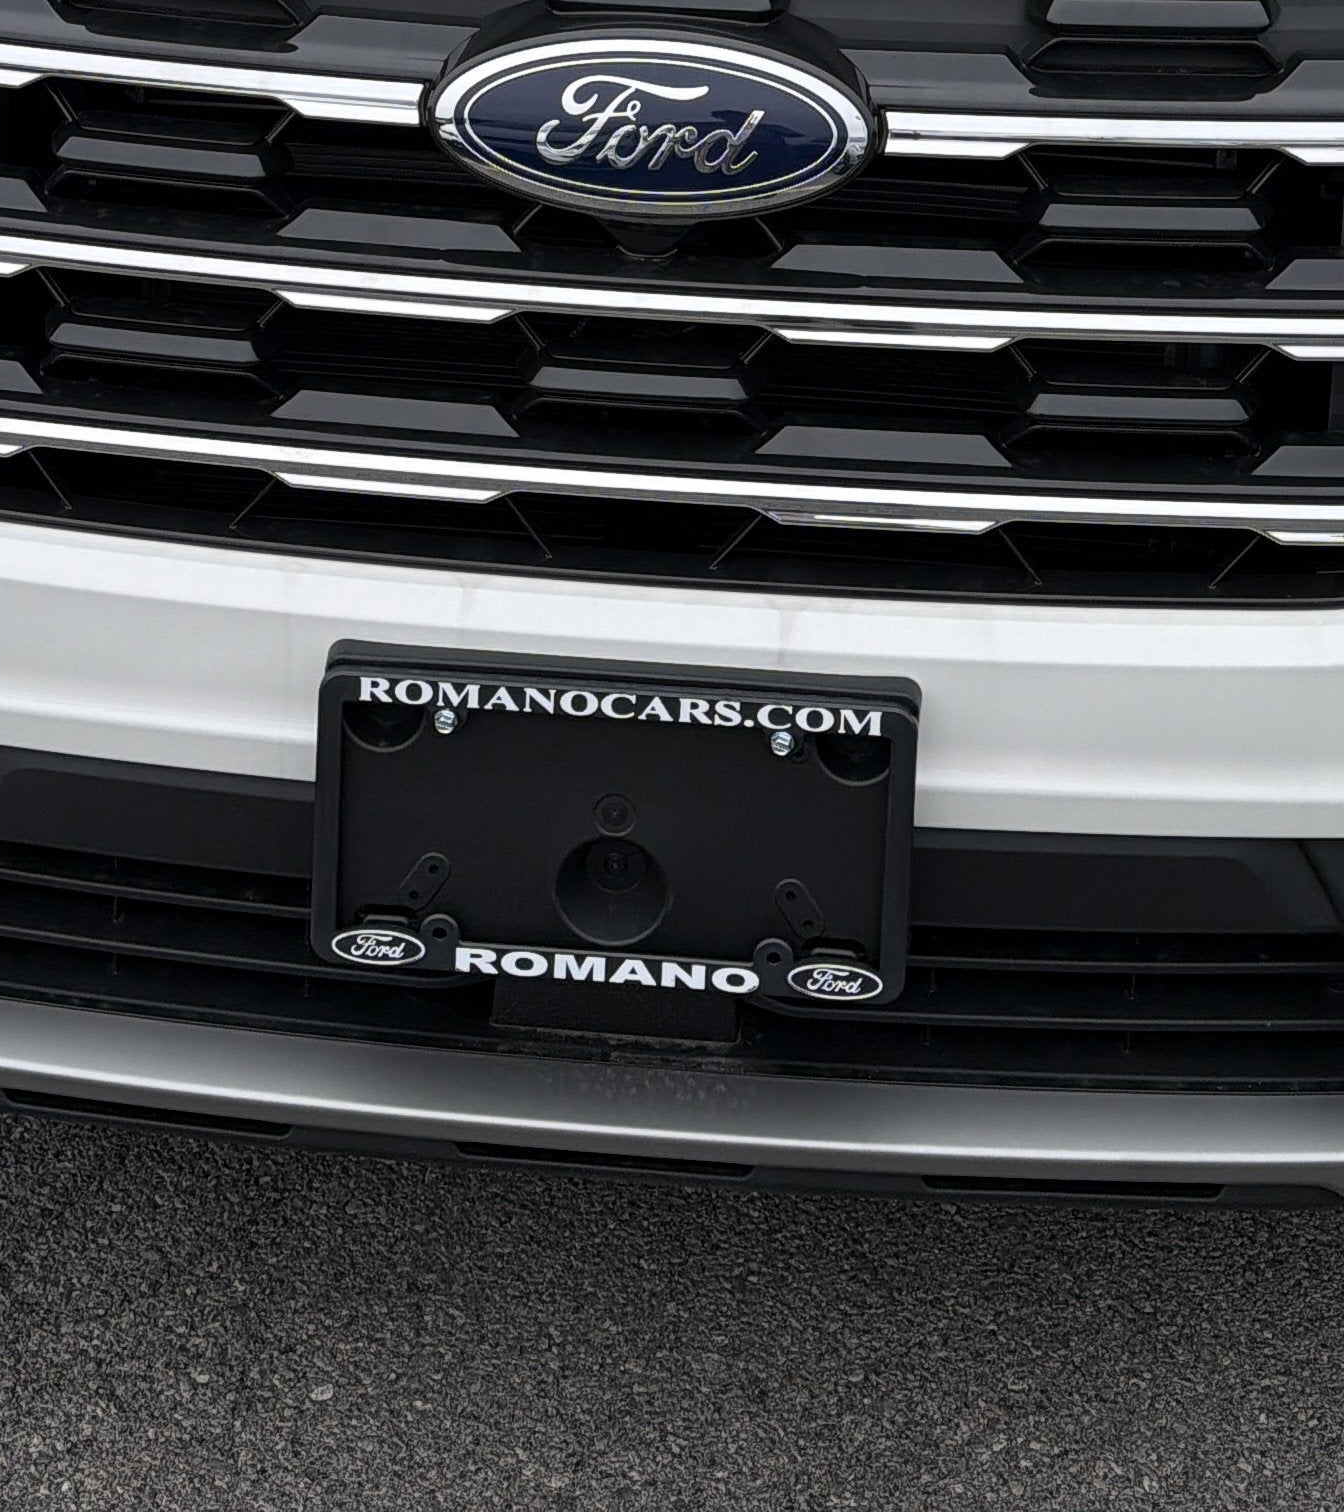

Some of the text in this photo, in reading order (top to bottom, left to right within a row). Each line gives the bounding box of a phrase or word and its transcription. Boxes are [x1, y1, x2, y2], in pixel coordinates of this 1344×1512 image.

[534, 74, 766, 177] Ford
[358, 676, 883, 737] ROMANOCARS.COM
[350, 933, 405, 960] Ford
[454, 946, 760, 994] ROMANO
[806, 968, 863, 995] Ford
